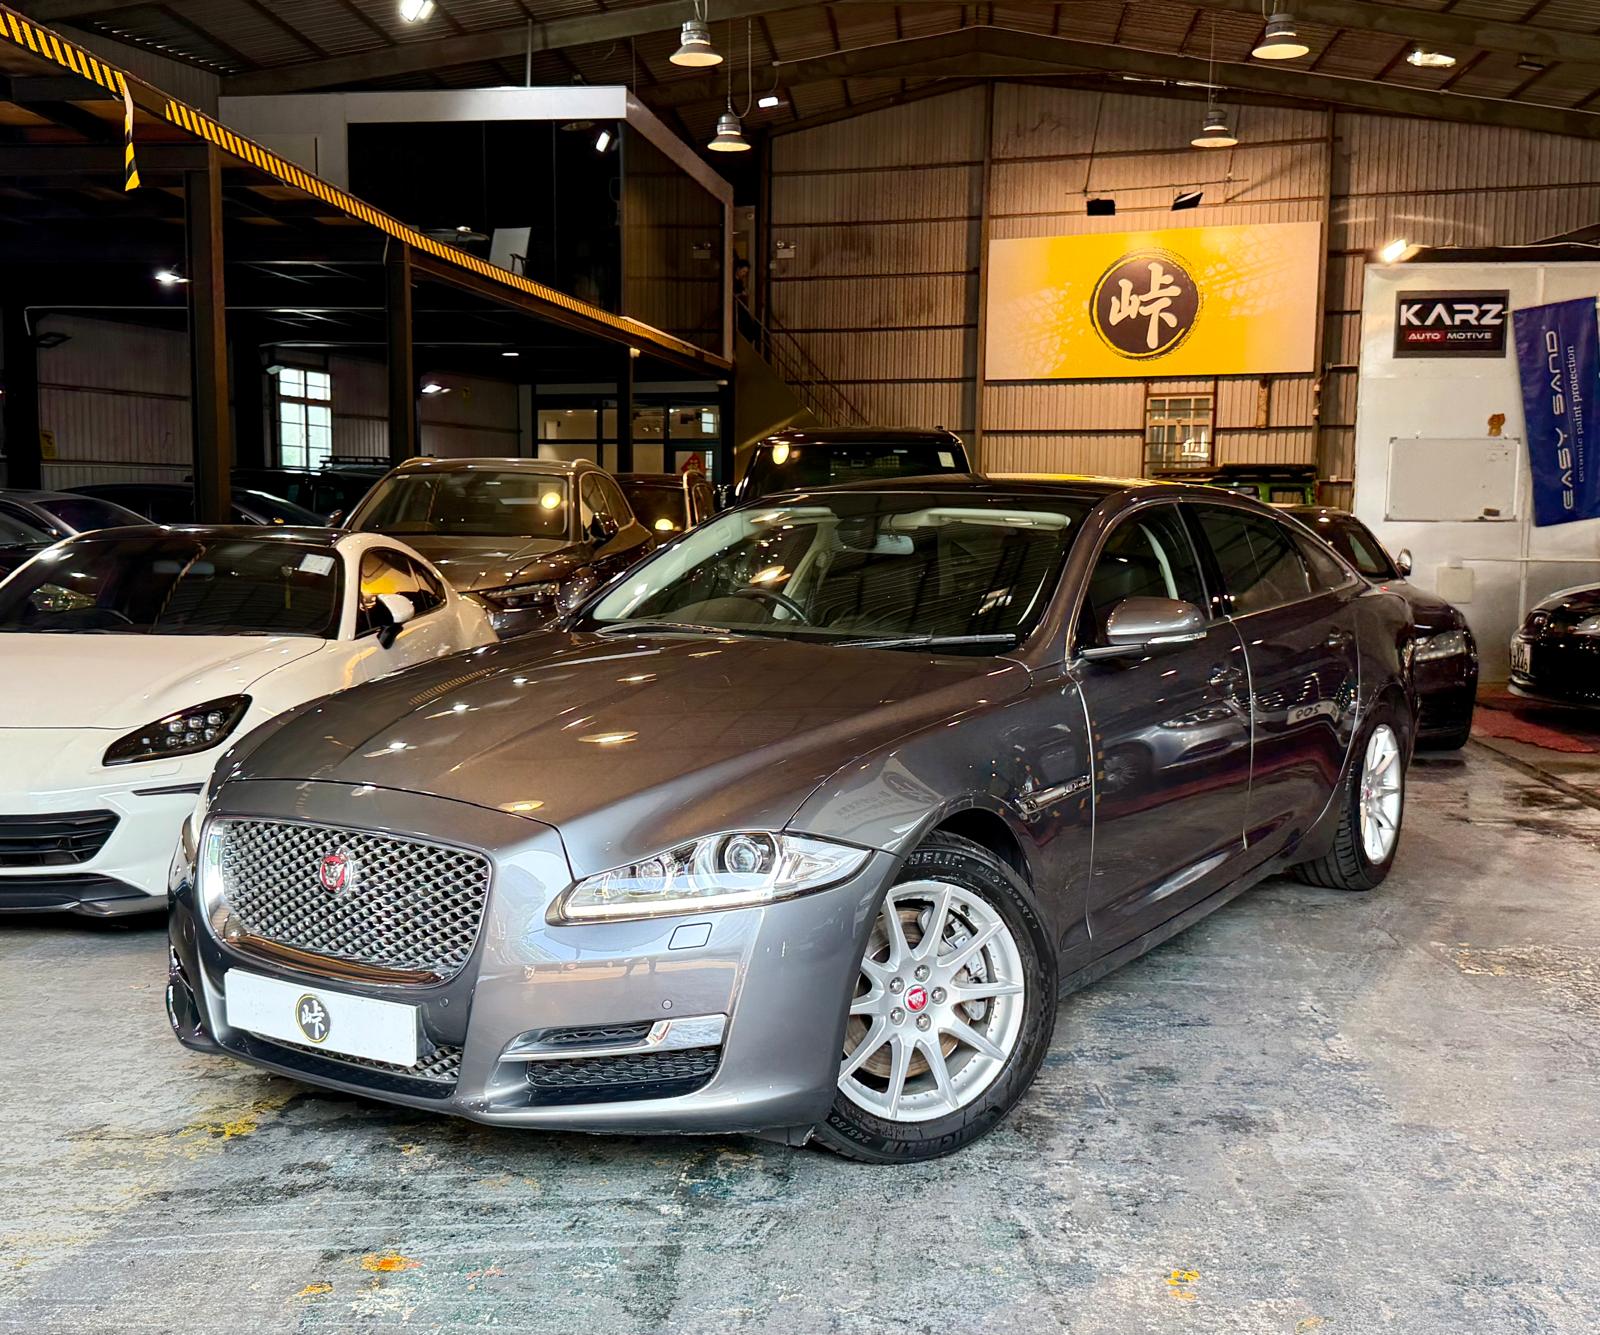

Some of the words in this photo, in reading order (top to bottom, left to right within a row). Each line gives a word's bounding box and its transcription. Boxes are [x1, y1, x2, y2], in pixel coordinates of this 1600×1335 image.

[1109, 262, 1182, 349] 峠
[1399, 303, 1504, 326] KARZ
[1408, 332, 1442, 340] AUTO
[1446, 332, 1493, 340] MOTIVE
[1545, 330, 1565, 416] SAND
[1566, 345, 1583, 403] protection
[1572, 406, 1584, 435] paint
[1555, 426, 1574, 510] EASY
[1576, 438, 1585, 483] ceramic
[301, 999, 326, 1040] 峠
